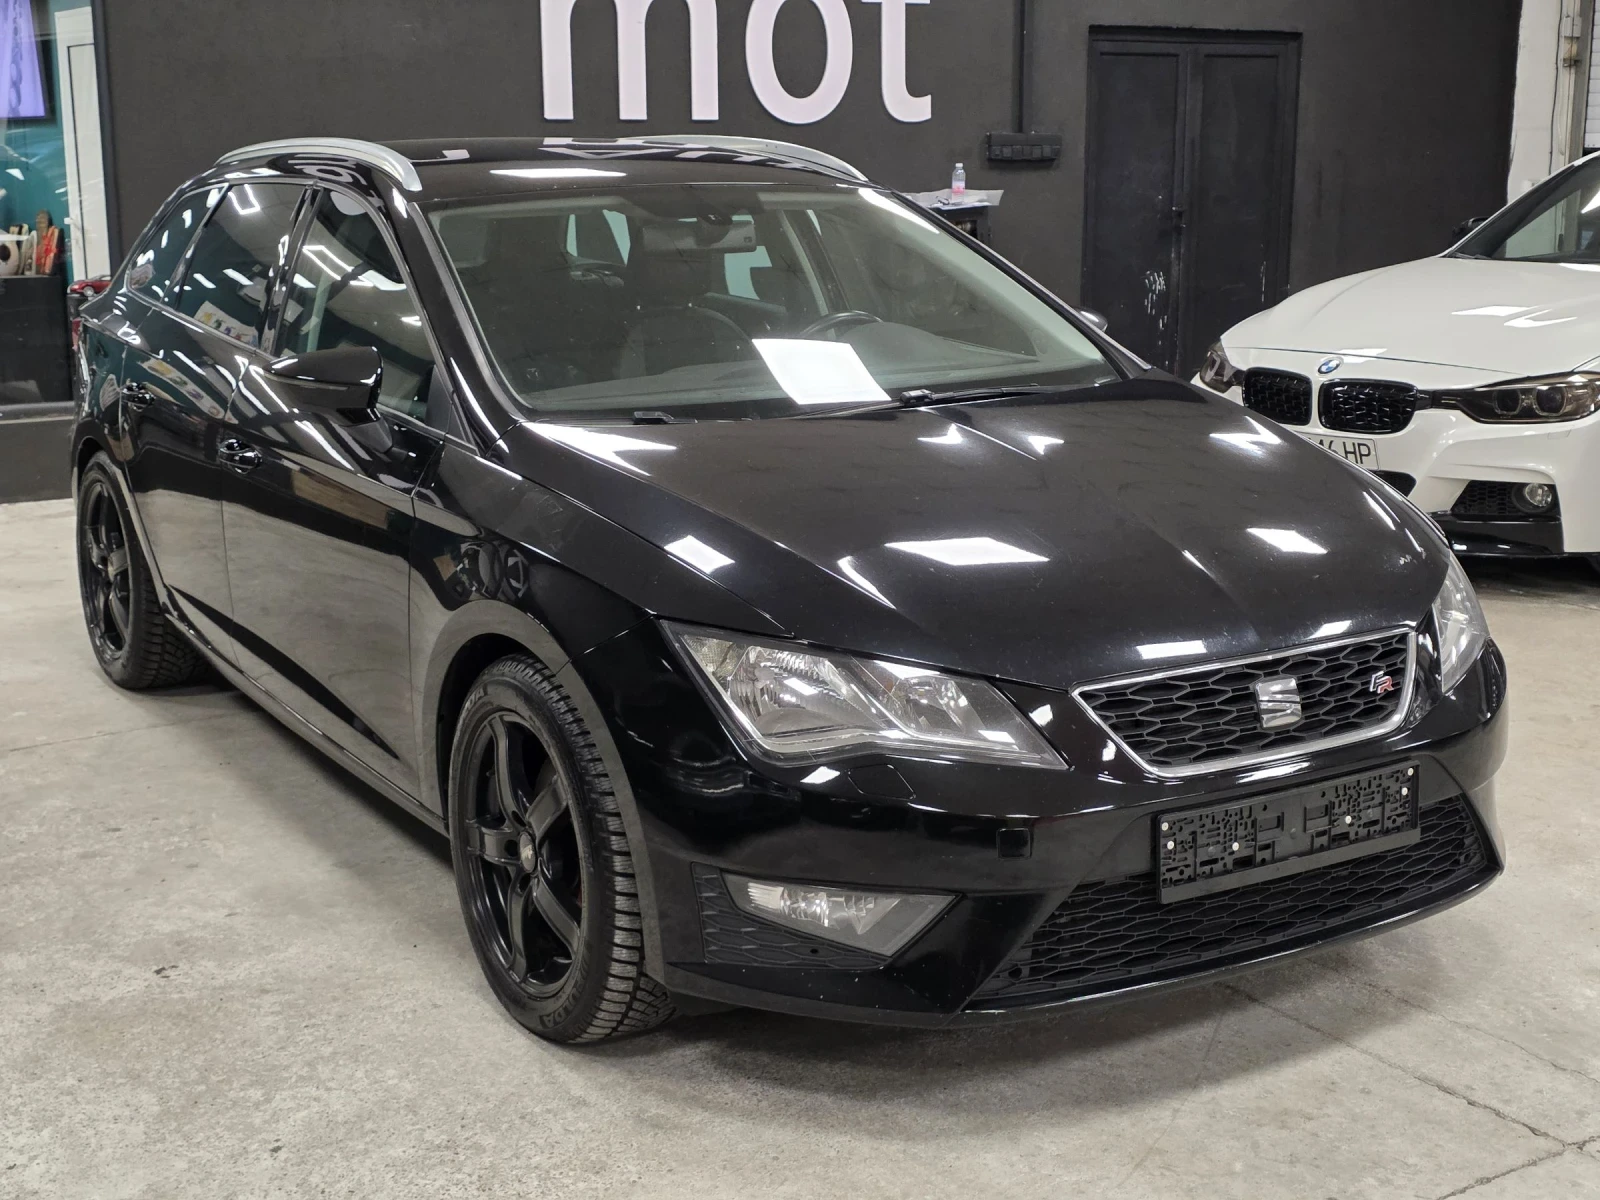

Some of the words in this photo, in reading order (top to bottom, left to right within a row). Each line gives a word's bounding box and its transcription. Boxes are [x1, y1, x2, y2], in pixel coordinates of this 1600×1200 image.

[540, 0, 932, 124] mot
[1342, 441, 1371, 464] HP
[1369, 670, 1395, 694] FR
